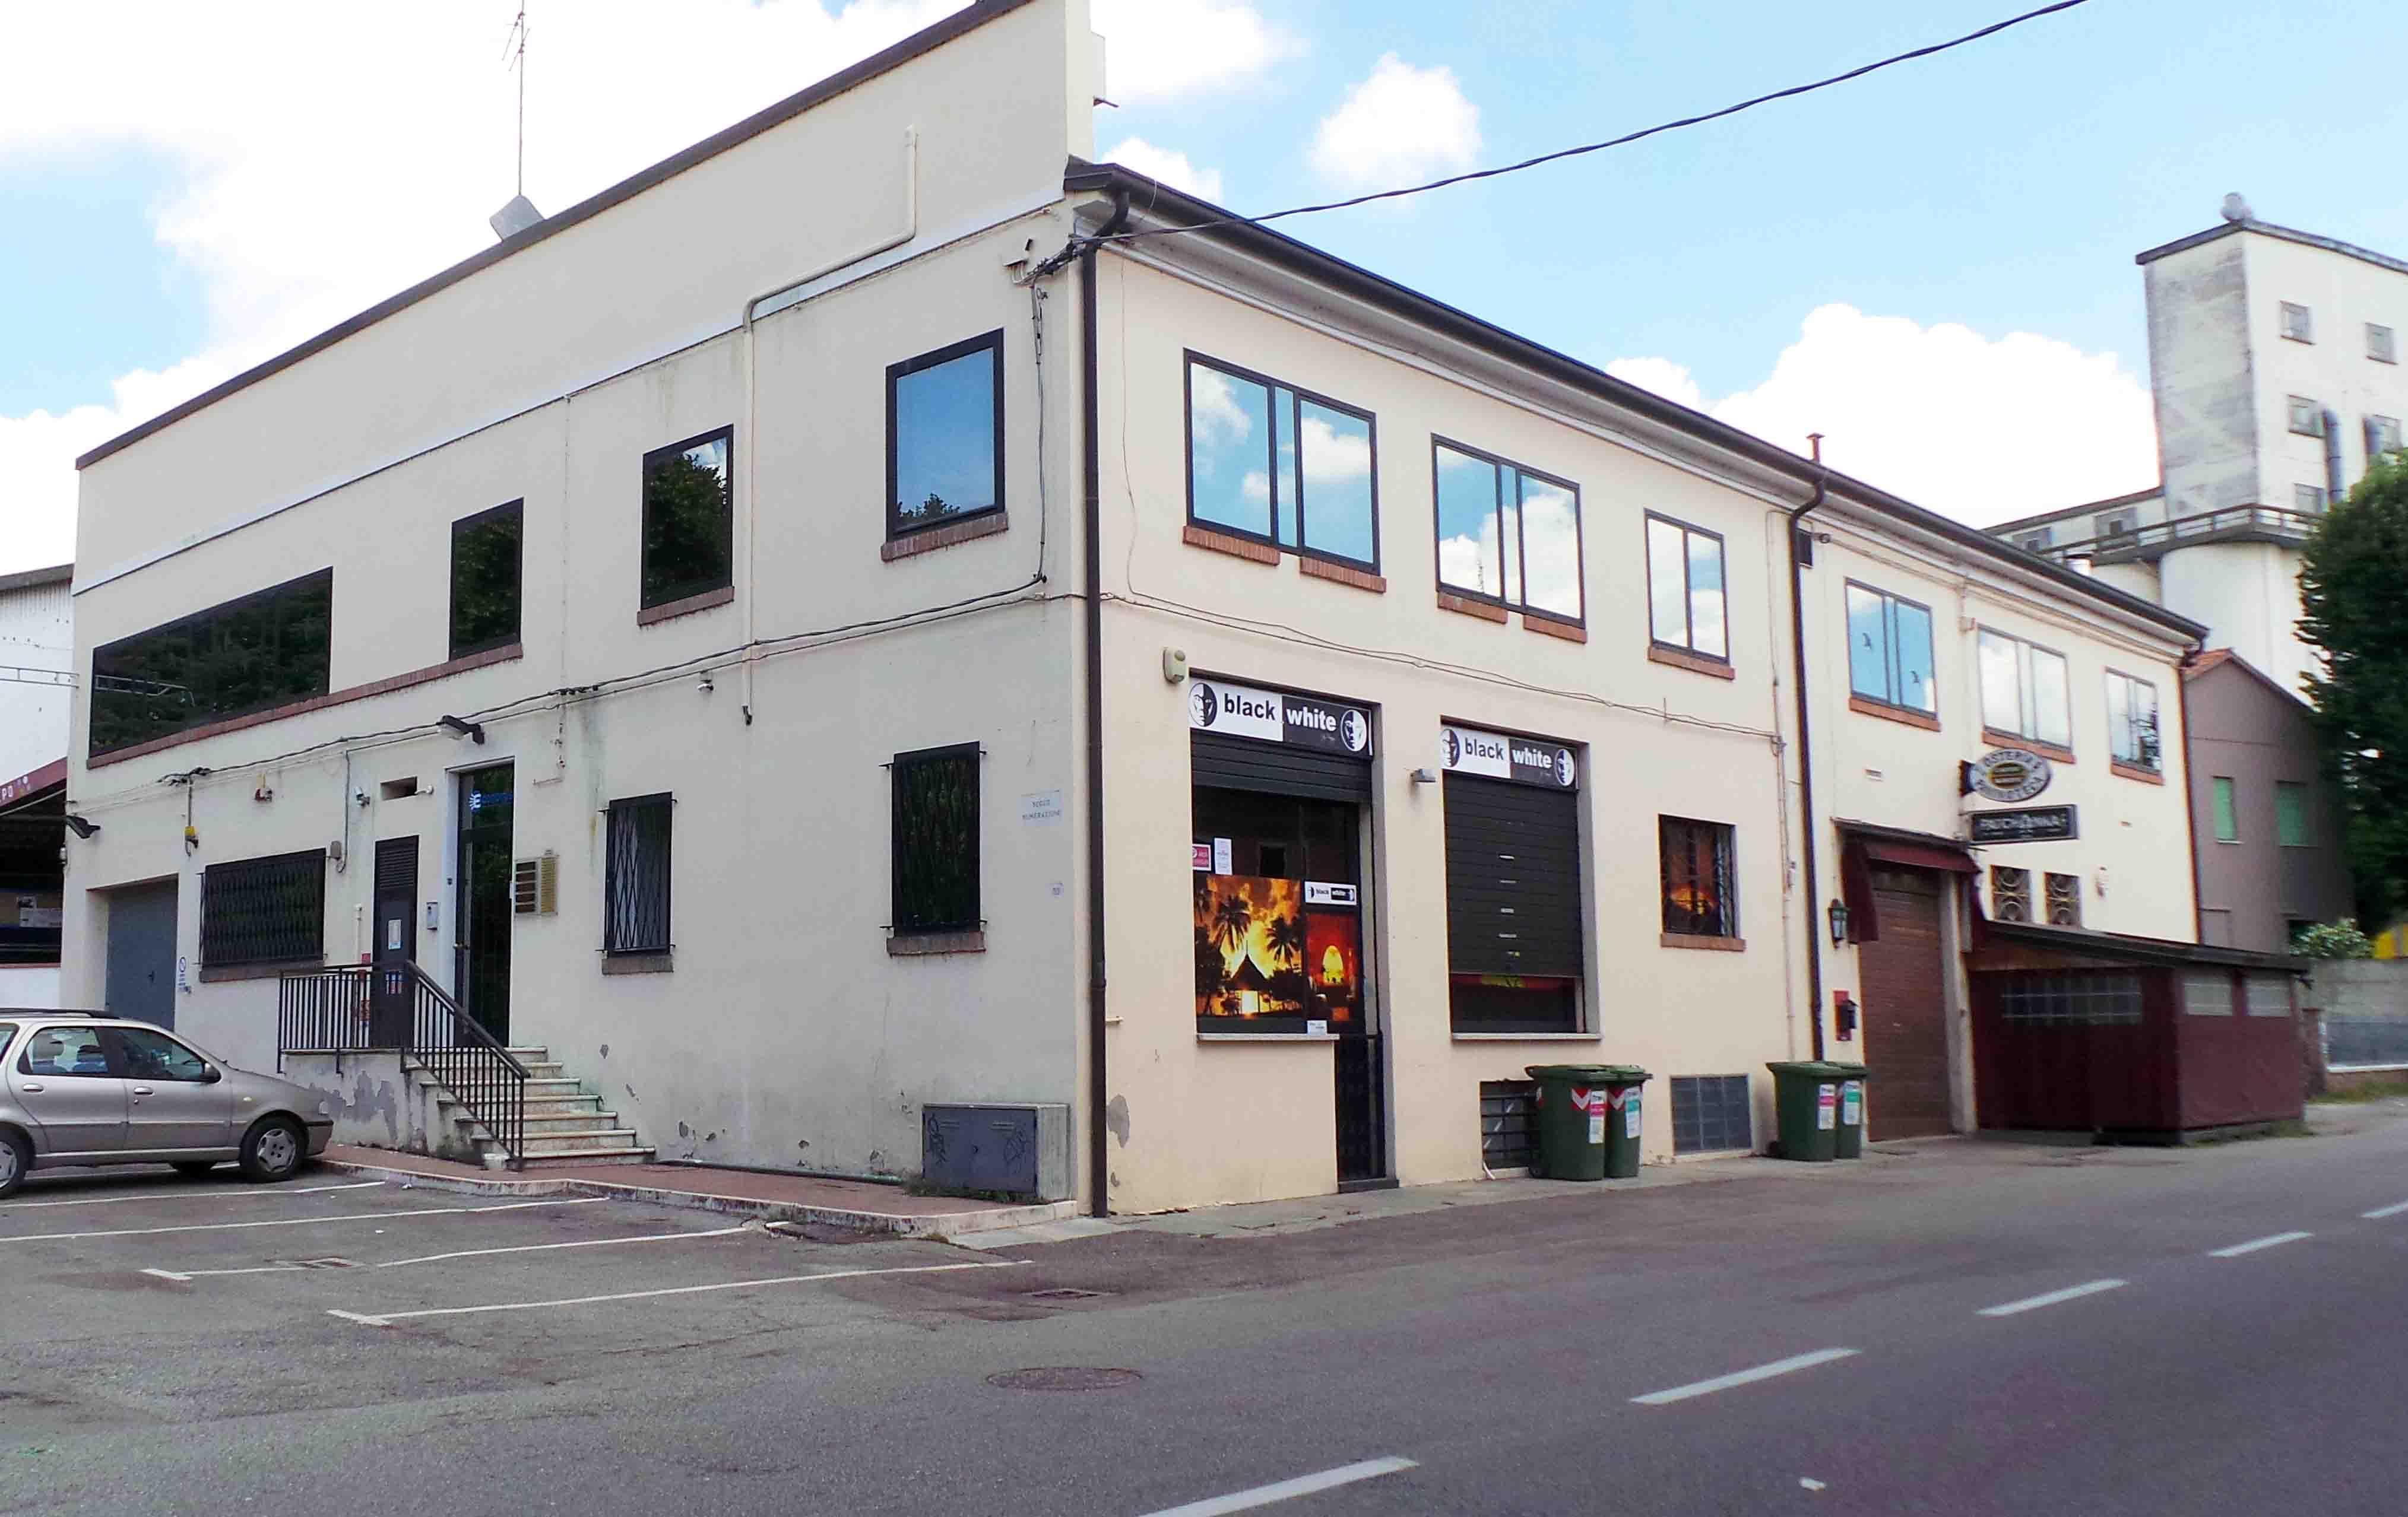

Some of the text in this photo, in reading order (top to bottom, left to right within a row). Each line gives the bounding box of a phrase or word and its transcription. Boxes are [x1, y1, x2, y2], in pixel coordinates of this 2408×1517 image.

[1224, 693, 1337, 732] black white
[1465, 737, 1552, 769] black white
